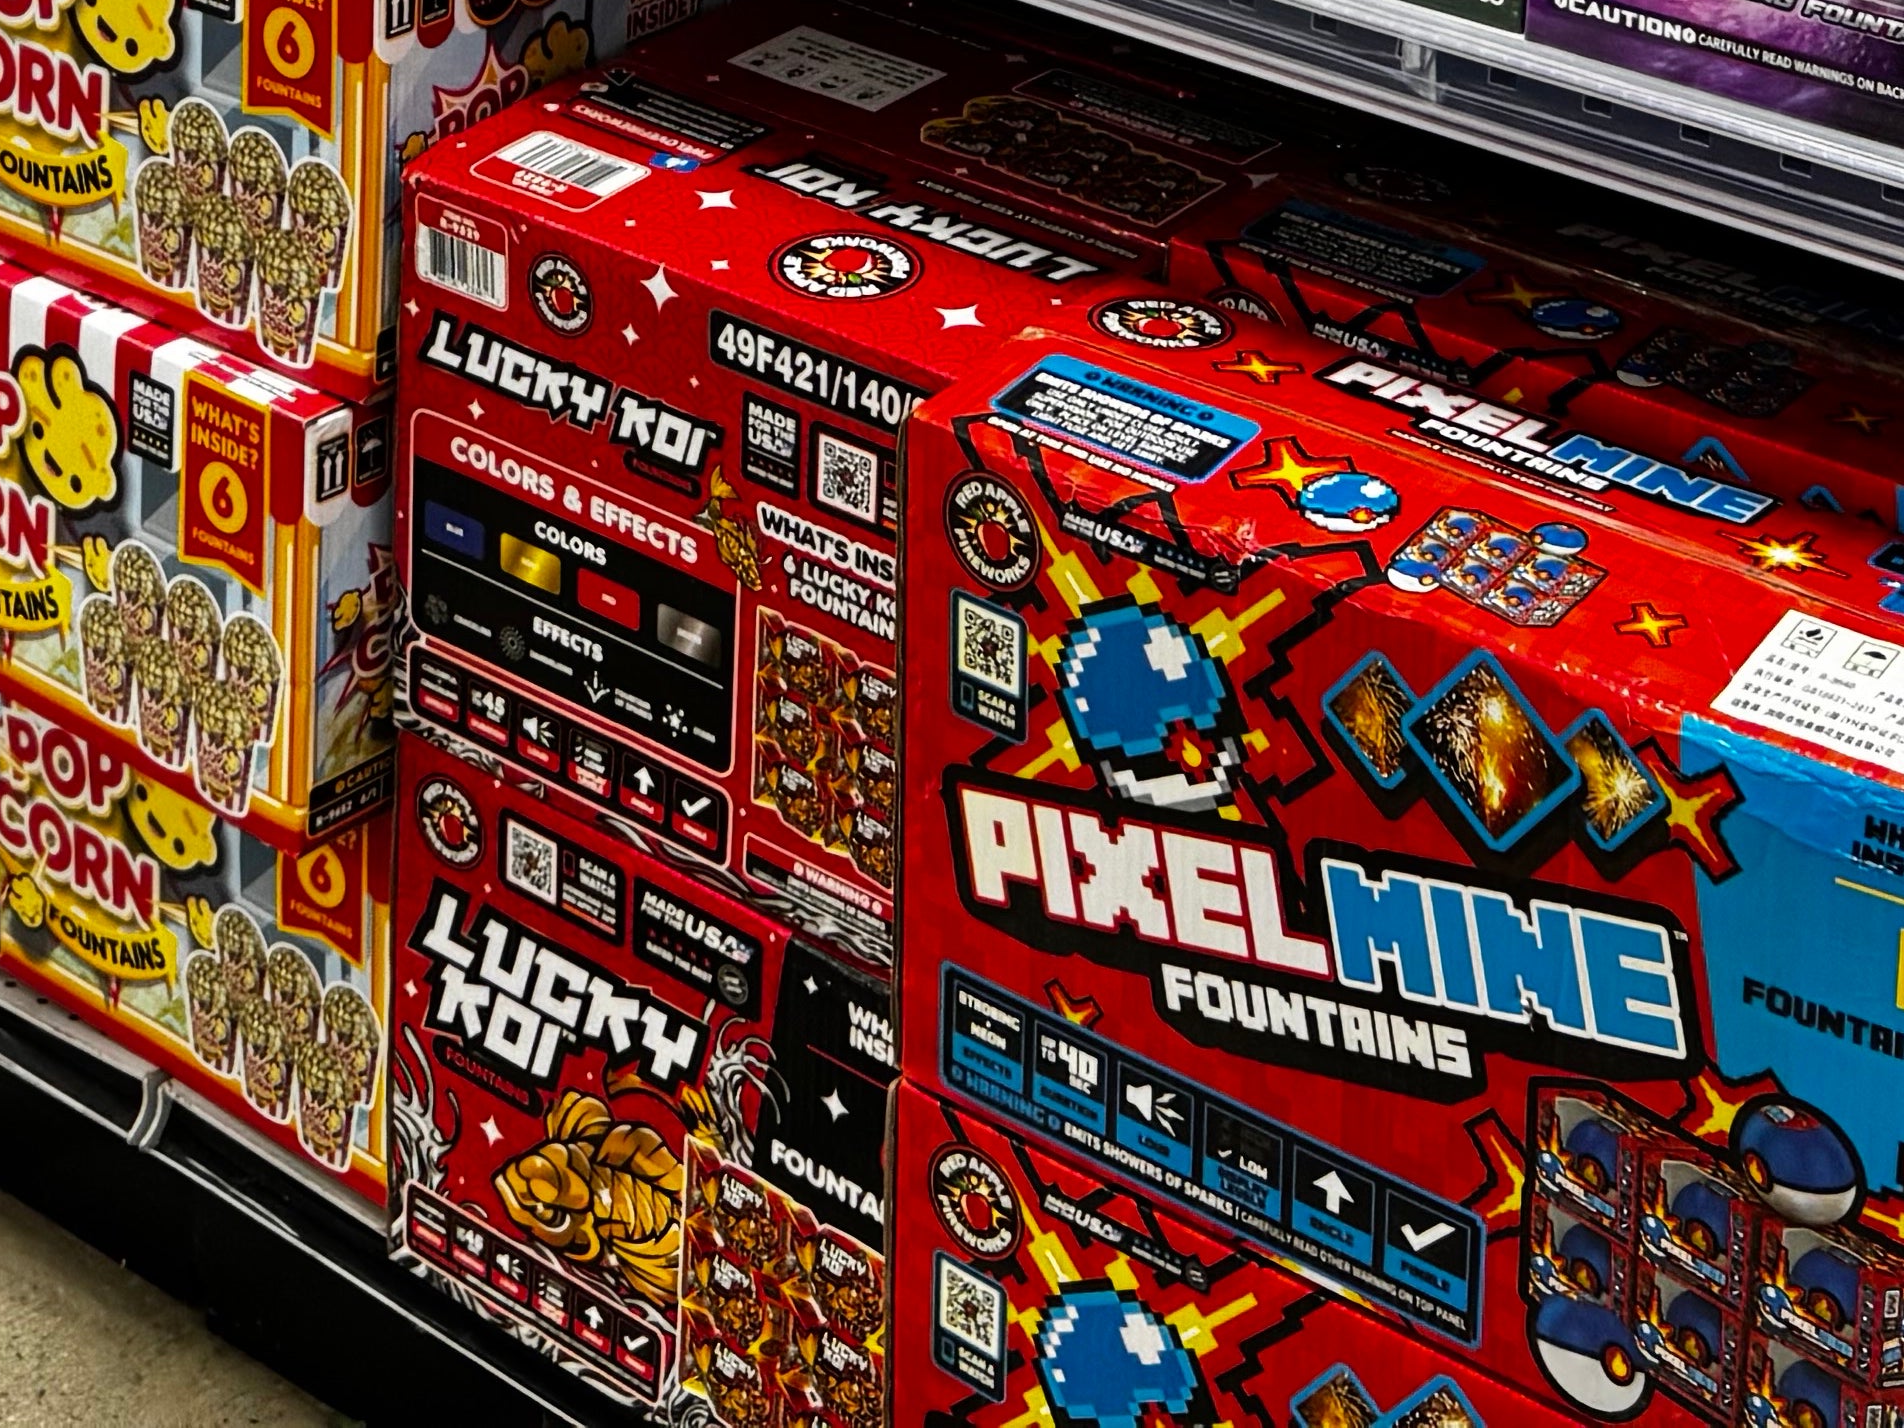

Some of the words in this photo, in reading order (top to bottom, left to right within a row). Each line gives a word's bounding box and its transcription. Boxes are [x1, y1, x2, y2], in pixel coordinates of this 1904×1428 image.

[276, 23, 302, 60] 6
[256, 75, 323, 109] FOUNTAINS
[427, 318, 608, 424] LUCKY
[614, 399, 708, 468] KOI
[450, 435, 555, 501] COLORS
[563, 483, 583, 515] &
[590, 501, 697, 564] EFFECTS
[534, 521, 607, 566] COLORS
[532, 617, 605, 665] EFFECTS
[424, 891, 699, 1081] LUCKY
[1161, 964, 1473, 1079] FOUNTAINS
[440, 966, 563, 1081] KOI
[1058, 1039, 1098, 1086] 40
[1069, 1076, 1091, 1095] SEC
[1064, 1122, 1101, 1154] EMITS
[1103, 1140, 1161, 1182] SHOWERS
[1164, 1167, 1182, 1190] OF
[1184, 1181, 1234, 1218] SPARKS
